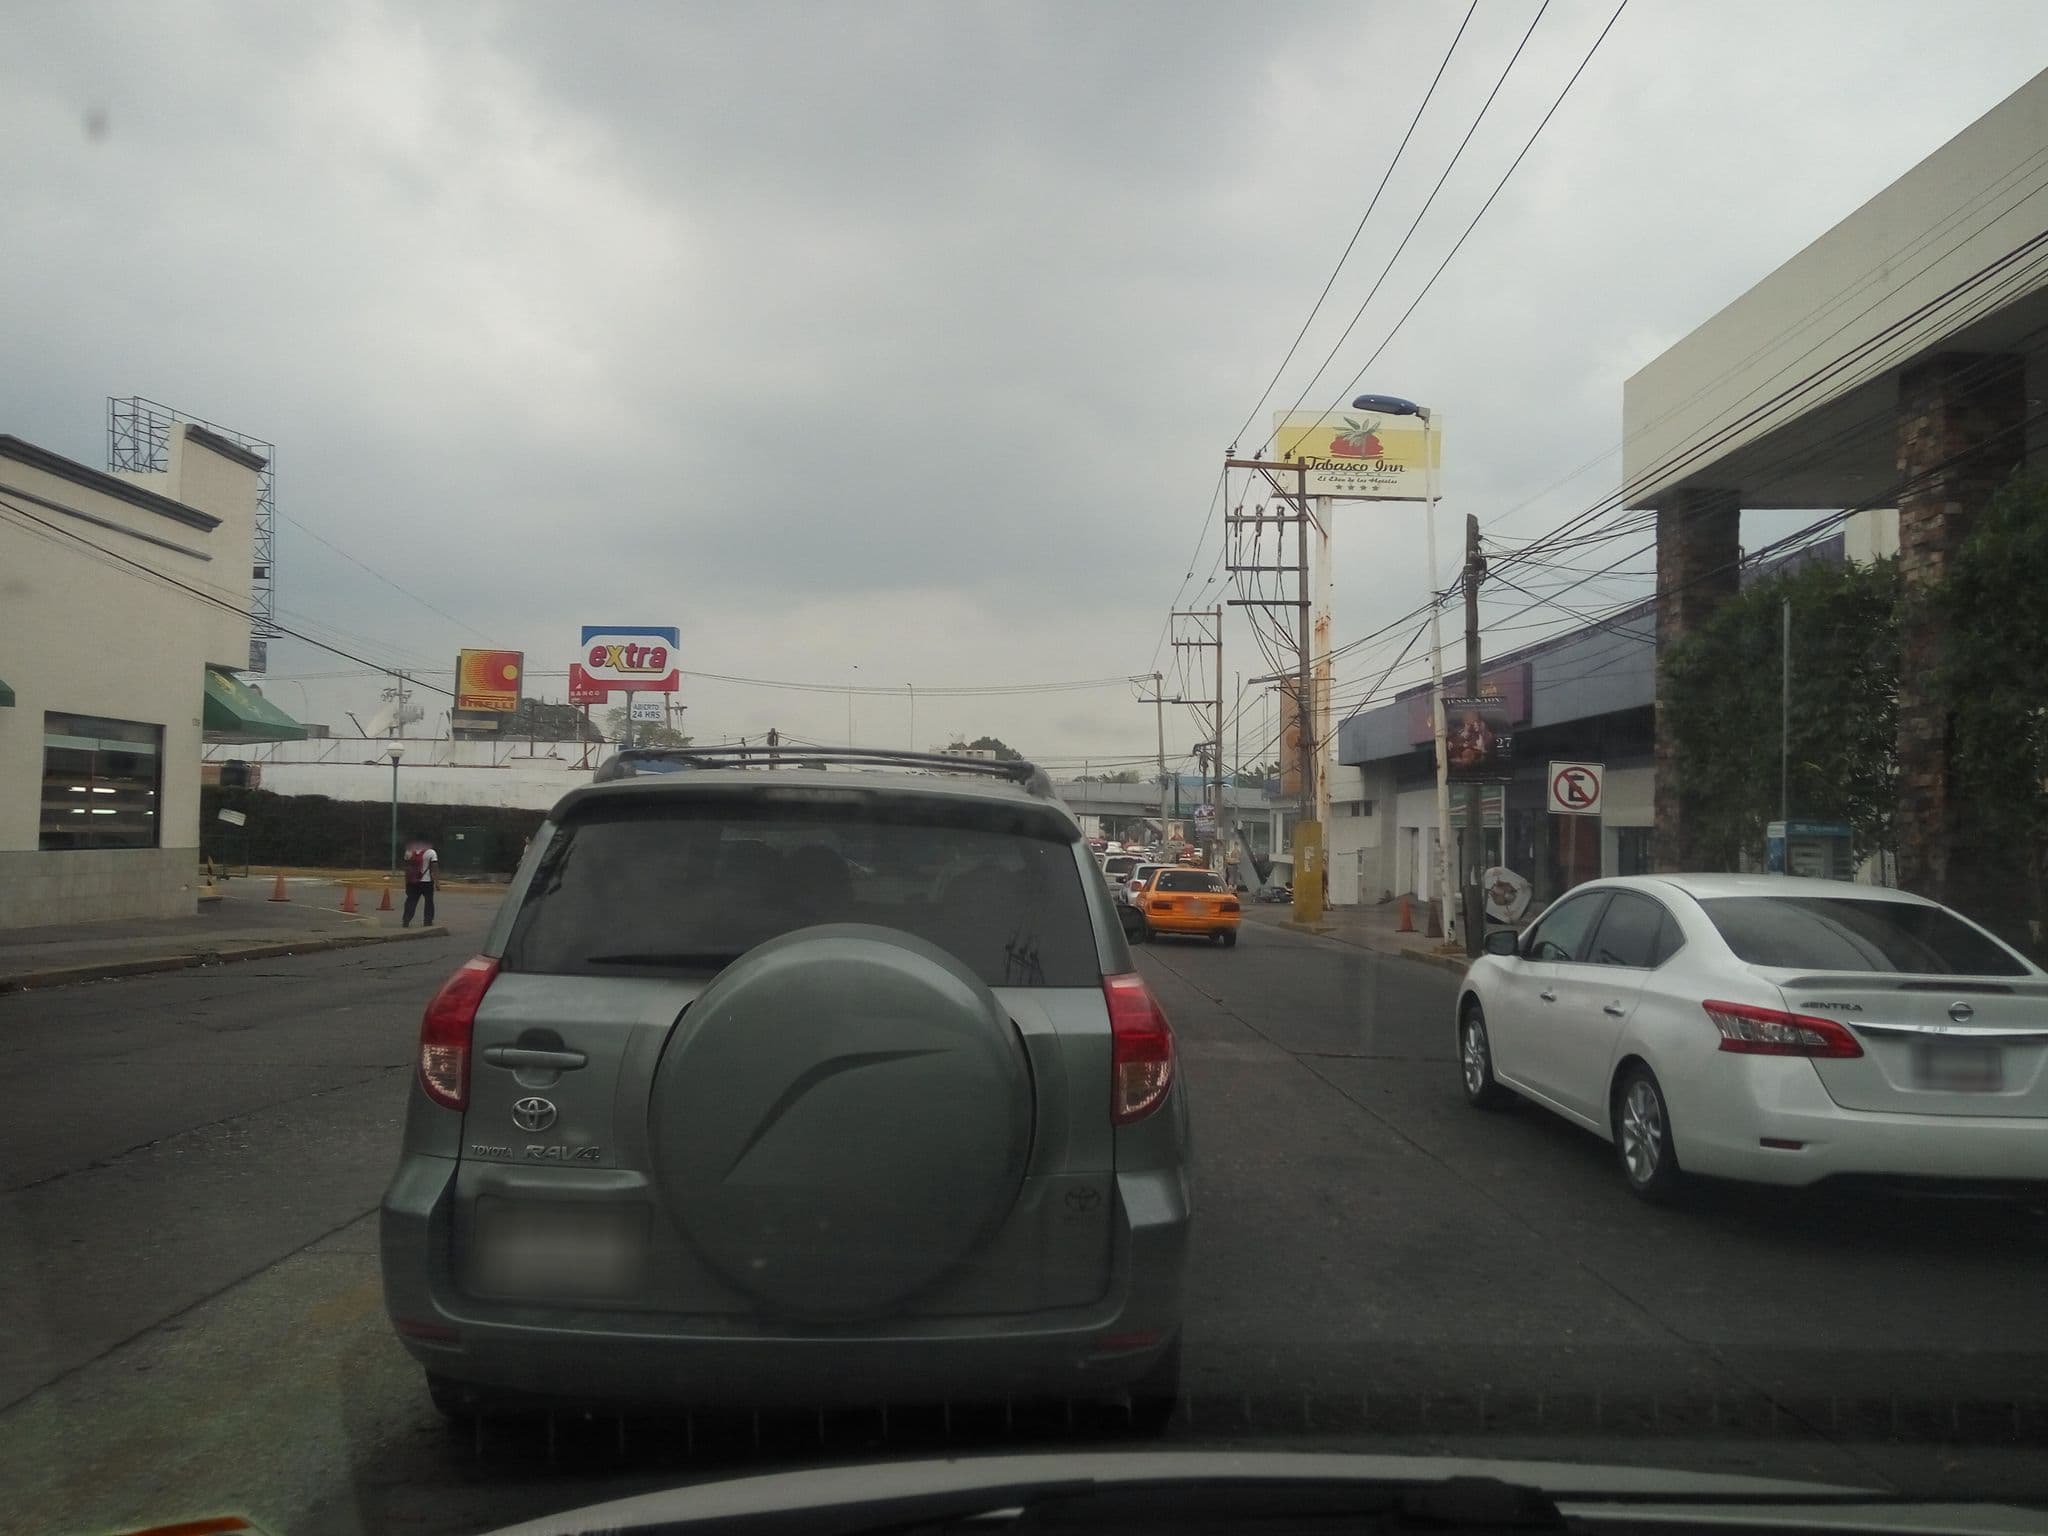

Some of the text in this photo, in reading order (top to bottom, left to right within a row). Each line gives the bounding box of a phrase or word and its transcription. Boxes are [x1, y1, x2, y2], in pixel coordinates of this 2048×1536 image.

[1306, 456, 1407, 473] Tabasco Inn
[589, 642, 668, 673] extra
[460, 695, 515, 710] PIRELLI
[633, 703, 660, 711] ABIERTO
[632, 711, 661, 719] 24 HRS
[1496, 737, 1512, 748] 27
[1799, 1001, 1863, 1012] SENTRA
[471, 1144, 600, 1160] TOYOTA RAV4
